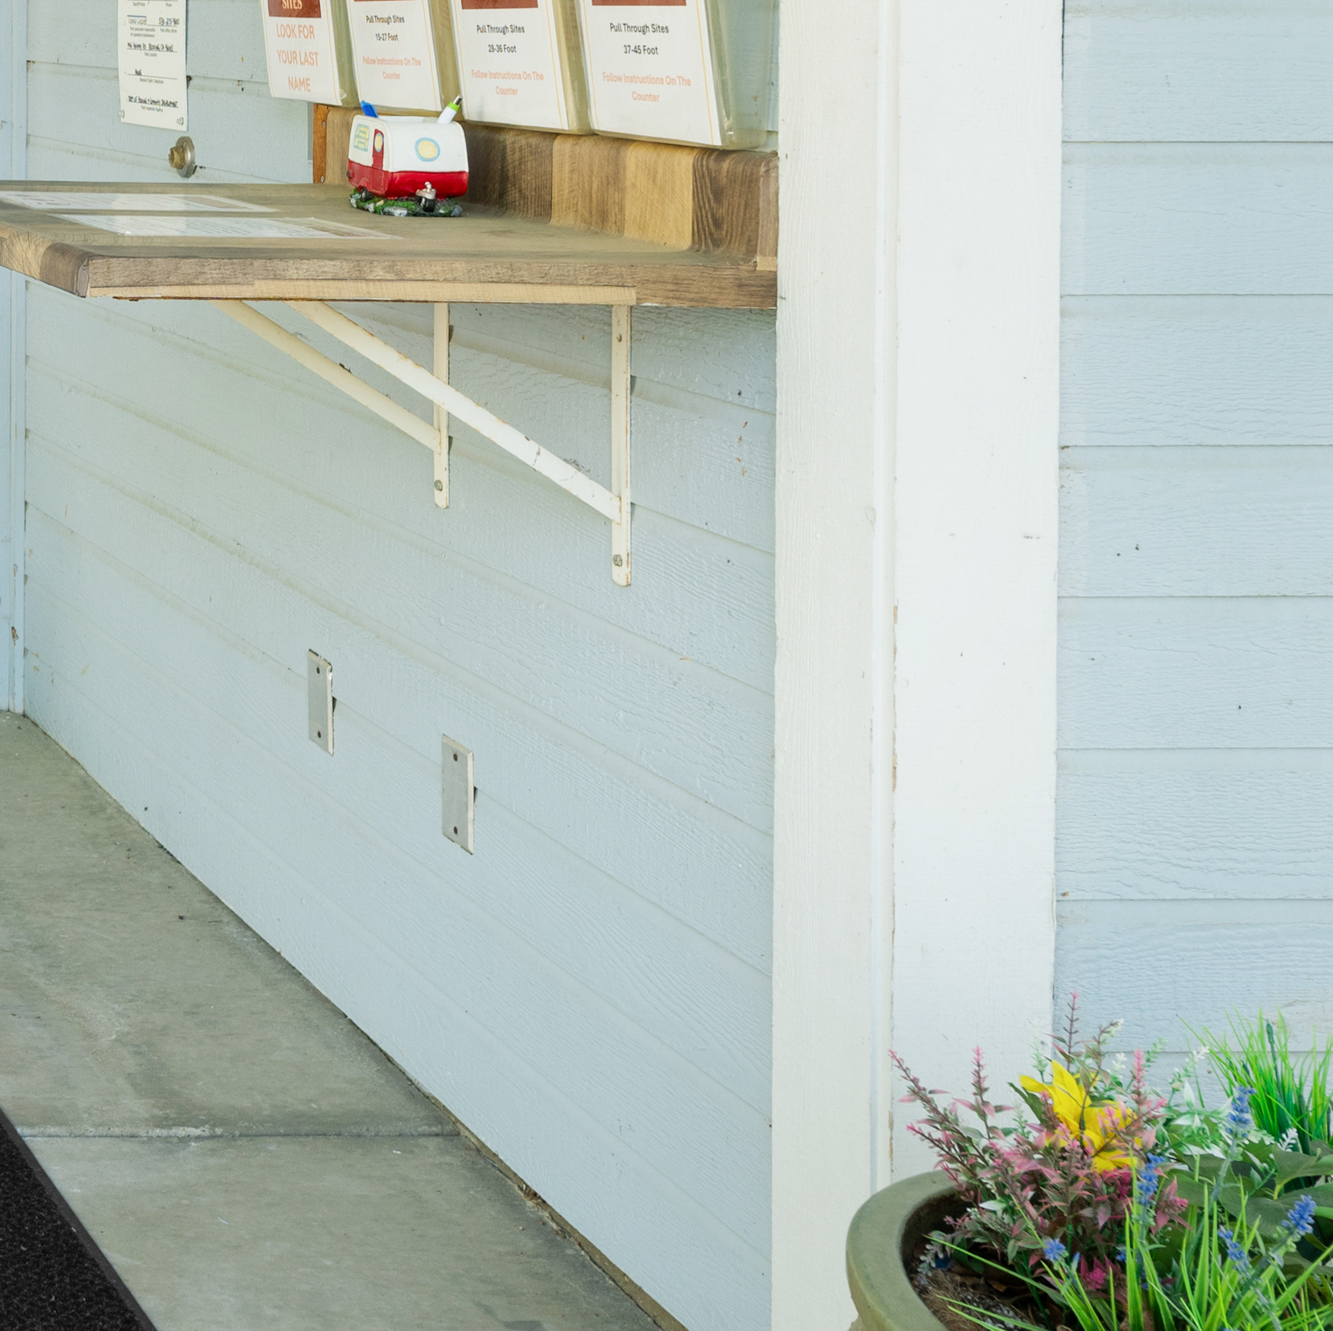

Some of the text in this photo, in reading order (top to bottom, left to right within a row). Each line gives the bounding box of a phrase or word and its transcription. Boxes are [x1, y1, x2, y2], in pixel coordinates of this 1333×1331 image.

[276, 24, 315, 39] LOOK FOR
[477, 25, 525, 35] Pull Through Sites
[610, 23, 669, 35] Pull Through Sites
[504, 45, 516, 53] Foot
[623, 45, 658, 55] 37-45 Foot
[277, 50, 318, 66] YOUR LAST
[523, 72, 531, 80] On
[532, 71, 544, 80] The
[603, 72, 691, 86] Follow Instructions On The
[288, 77, 311, 92] NAME
[496, 87, 518, 95] Counter
[632, 91, 659, 102] Counter
